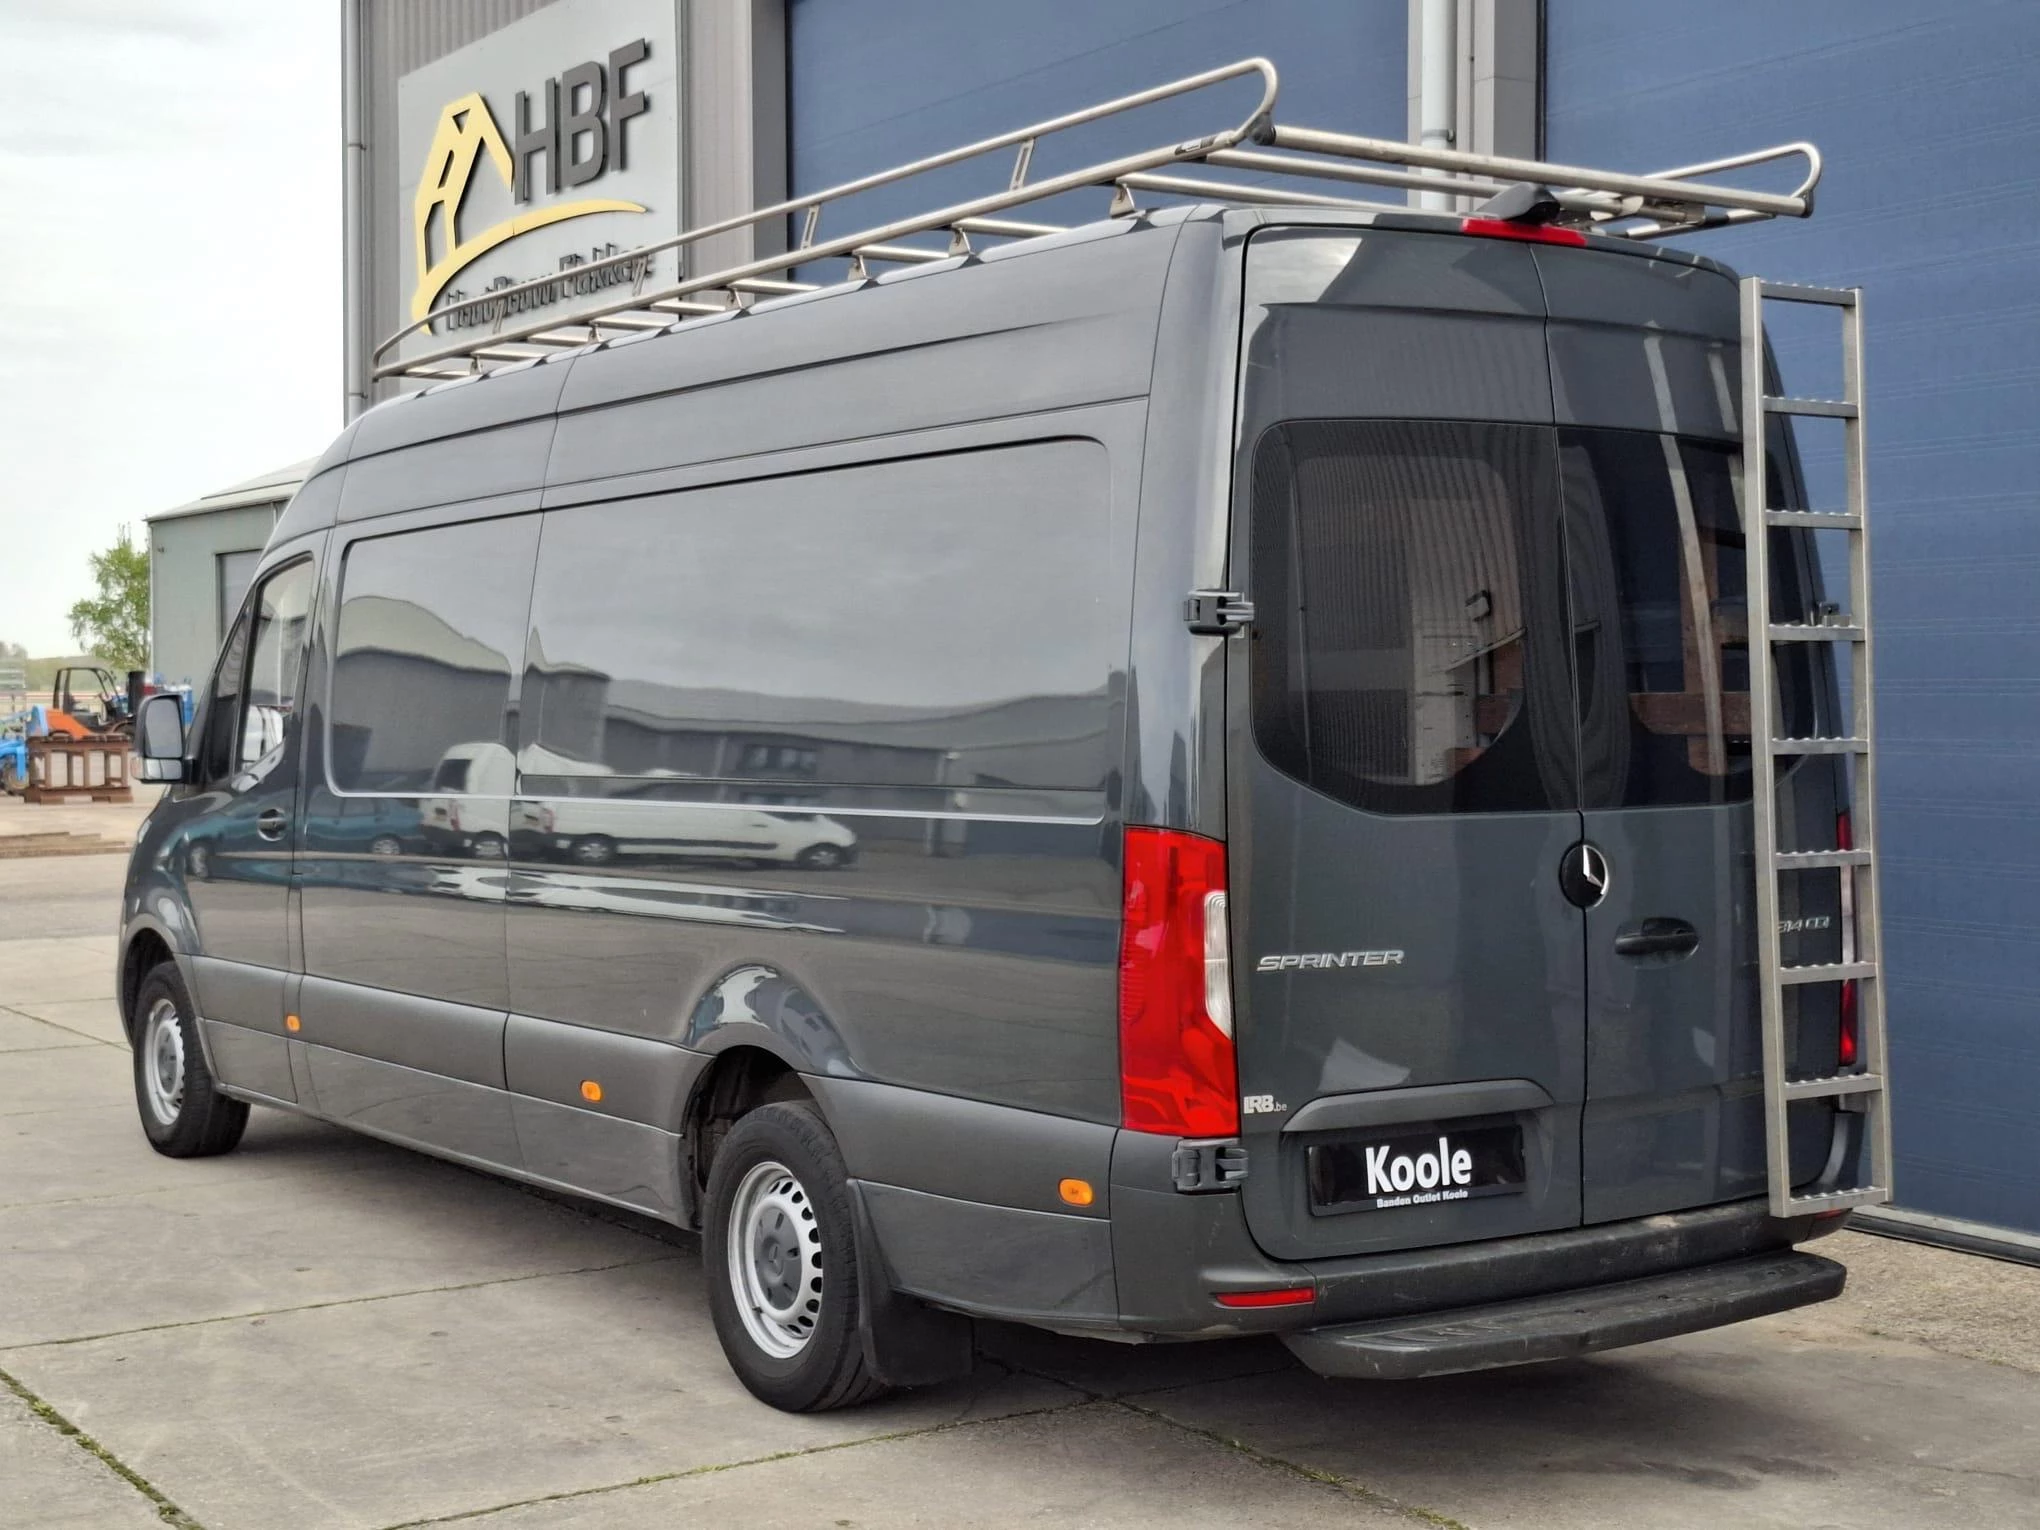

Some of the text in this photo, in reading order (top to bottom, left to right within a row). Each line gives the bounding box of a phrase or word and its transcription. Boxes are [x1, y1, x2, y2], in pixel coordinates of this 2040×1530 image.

[514, 38, 649, 205] HBF
[1256, 949, 1405, 972] SPRINTER
[1365, 1136, 1472, 1195] Koole
[1376, 1189, 1468, 1208] Banden Outlet Koole
